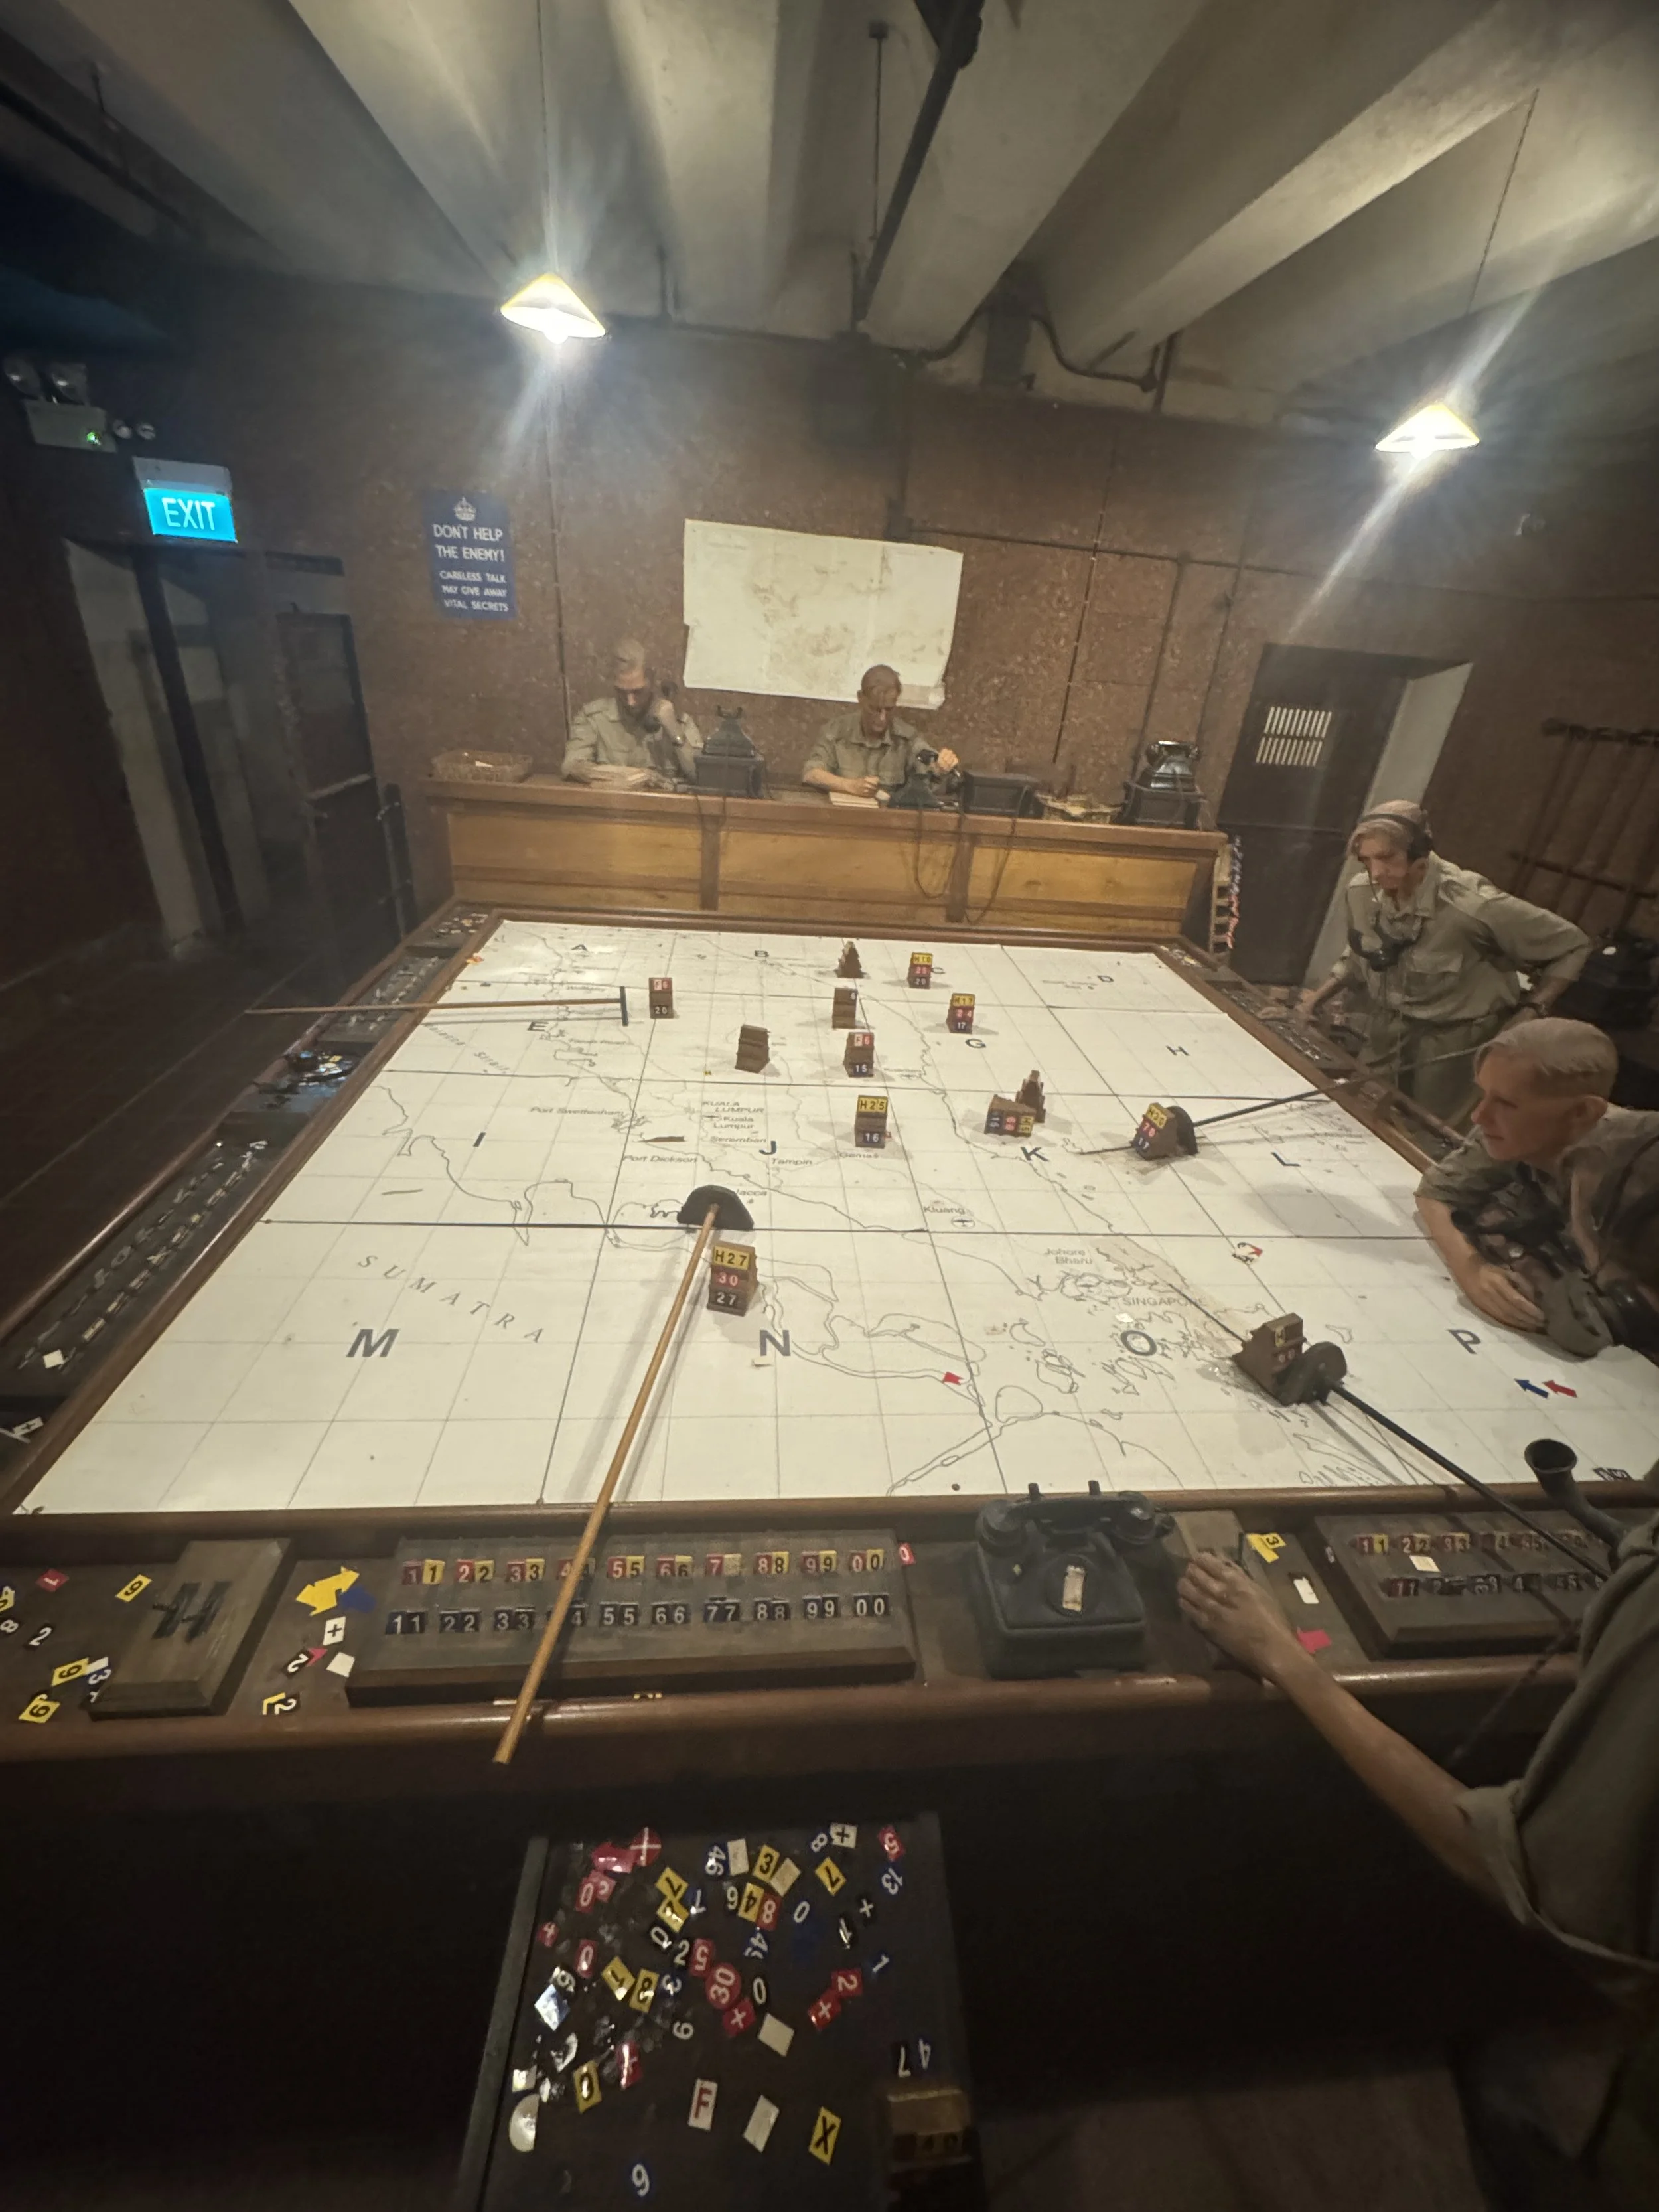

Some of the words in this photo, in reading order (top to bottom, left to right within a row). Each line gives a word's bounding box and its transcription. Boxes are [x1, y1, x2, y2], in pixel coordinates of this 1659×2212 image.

[162, 498, 215, 530] EXIT
[433, 524, 468, 539] DON'T
[473, 526, 503, 541] HELP
[435, 544, 458, 559] THE
[462, 546, 504, 562] ENEMY!
[439, 571, 482, 581] CARELESS
[486, 573, 506, 583] TALK
[441, 585, 458, 594] MAY
[461, 587, 480, 596] GIVE
[484, 588, 507, 597] AWAY
[444, 599, 467, 609] VITAL
[471, 601, 509, 612] SECRETS
[528, 1021, 549, 1031] E
[965, 1038, 986, 1049] G
[1166, 1045, 1190, 1057] H
[860, 1100, 885, 1110] H25
[865, 1132, 879, 1142] 16
[759, 1141, 776, 1155] J
[1021, 1147, 1049, 1161] K
[1271, 1151, 1301, 1167] L
[923, 1205, 966, 1215] Kluang
[715, 1250, 747, 1267] H27
[719, 1271, 739, 1286] 30
[358, 1254, 545, 1343] SUMATRA
[716, 1291, 737, 1306] 27
[345, 1329, 400, 1358] M
[759, 1329, 792, 1357] N
[1120, 1330, 1157, 1357] O
[1447, 1329, 1481, 1354] P
[898, 1546, 910, 1562] 0
[29, 1627, 52, 1646] 2
[274, 1698, 297, 1715] 2
[760, 1853, 773, 1874] 3
[763, 1899, 777, 1923] 8
[693, 2087, 713, 2119] F
[814, 2118, 837, 2155] X
